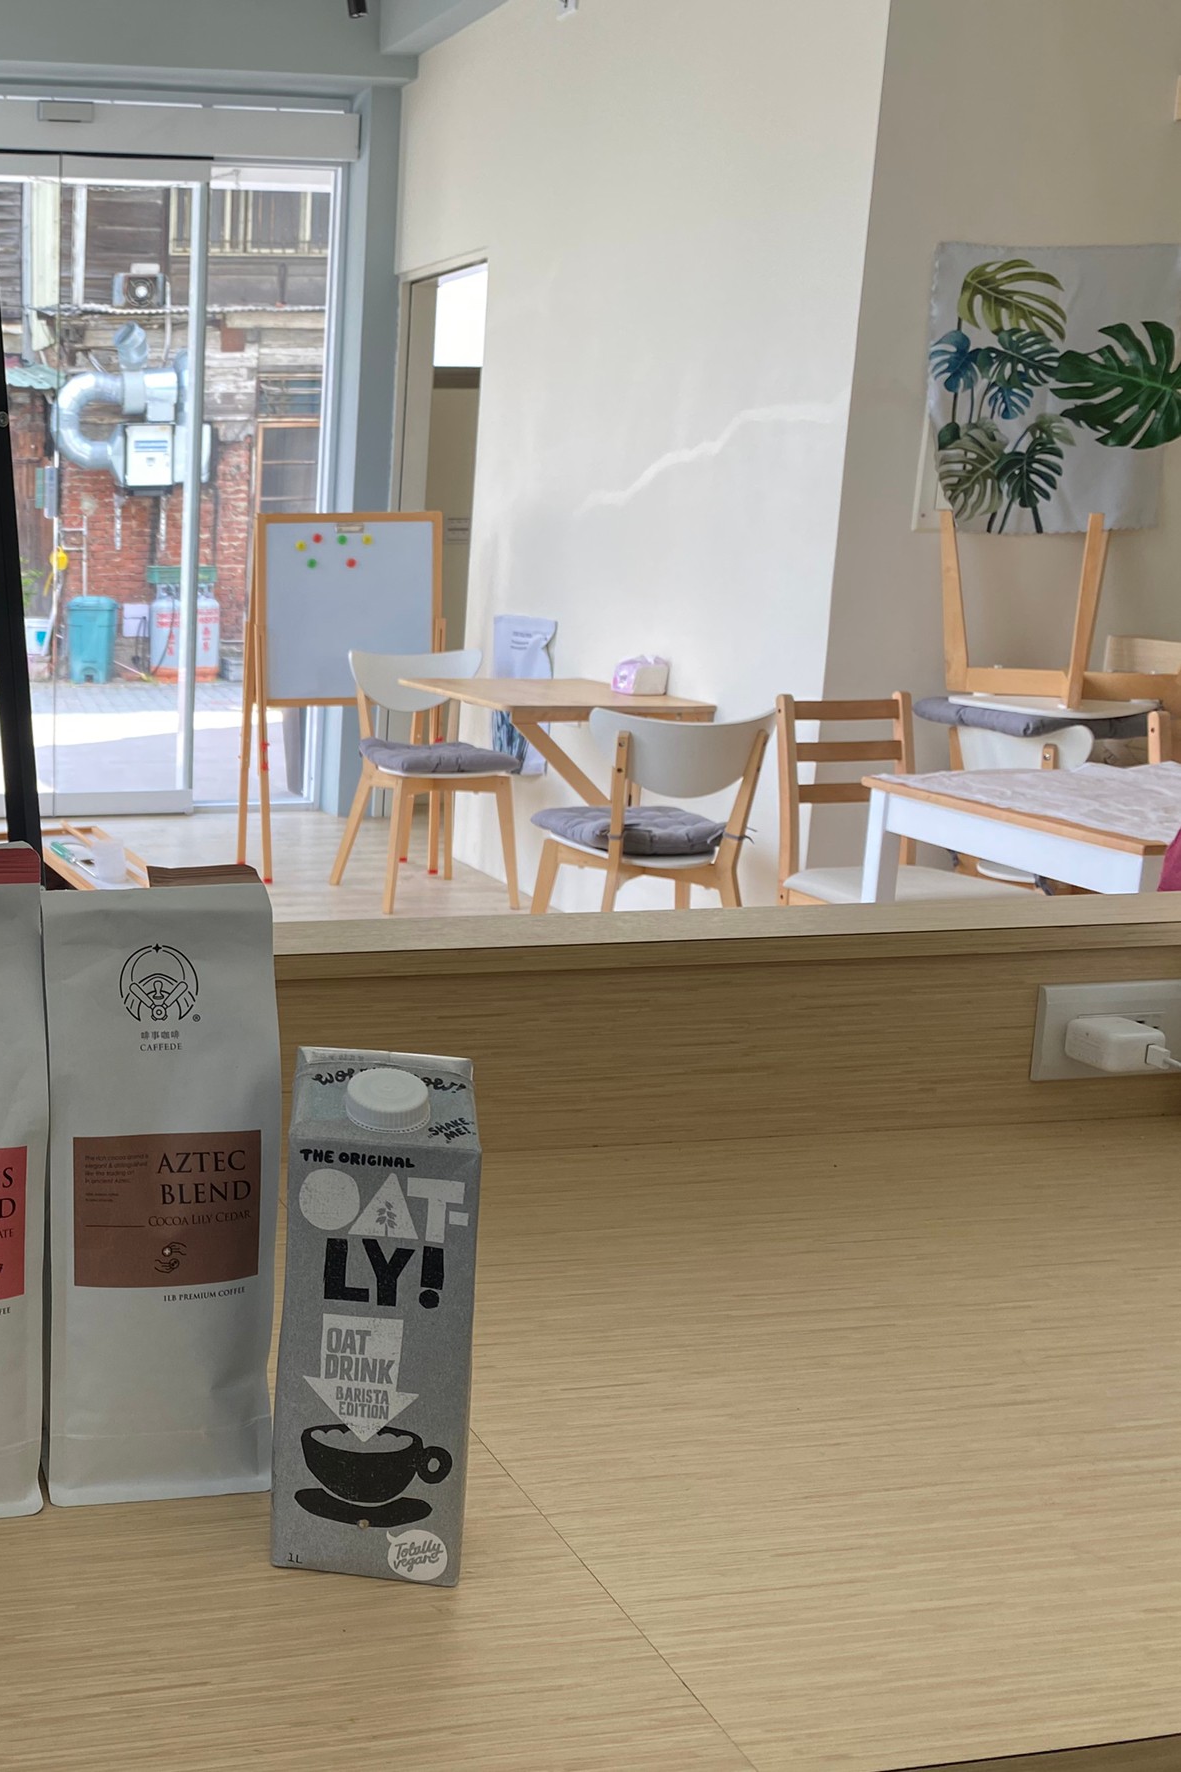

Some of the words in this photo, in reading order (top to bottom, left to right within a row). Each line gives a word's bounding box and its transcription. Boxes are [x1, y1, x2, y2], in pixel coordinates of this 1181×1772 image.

[140, 1043, 182, 1052] CAFFEDE
[428, 1117, 470, 1136] SHAKE
[157, 1149, 246, 1174] AZTEC
[300, 1148, 335, 1164] THE
[338, 1151, 416, 1168] ORIGINAL
[160, 1180, 252, 1205] BLEND
[148, 1215, 189, 1227] COCOA
[191, 1213, 213, 1225] LILY
[215, 1210, 252, 1223] CEDAR
[323, 1237, 445, 1310] LY!
[178, 1291, 217, 1301] PREMIUM
[217, 1286, 245, 1297] COFFEE
[326, 1327, 372, 1354] OAT
[324, 1354, 395, 1385] DRINK
[335, 1385, 390, 1405] BARISTA
[338, 1402, 390, 1420] EDITION
[394, 1539, 444, 1560] Totally
[393, 1554, 440, 1573] vegan
